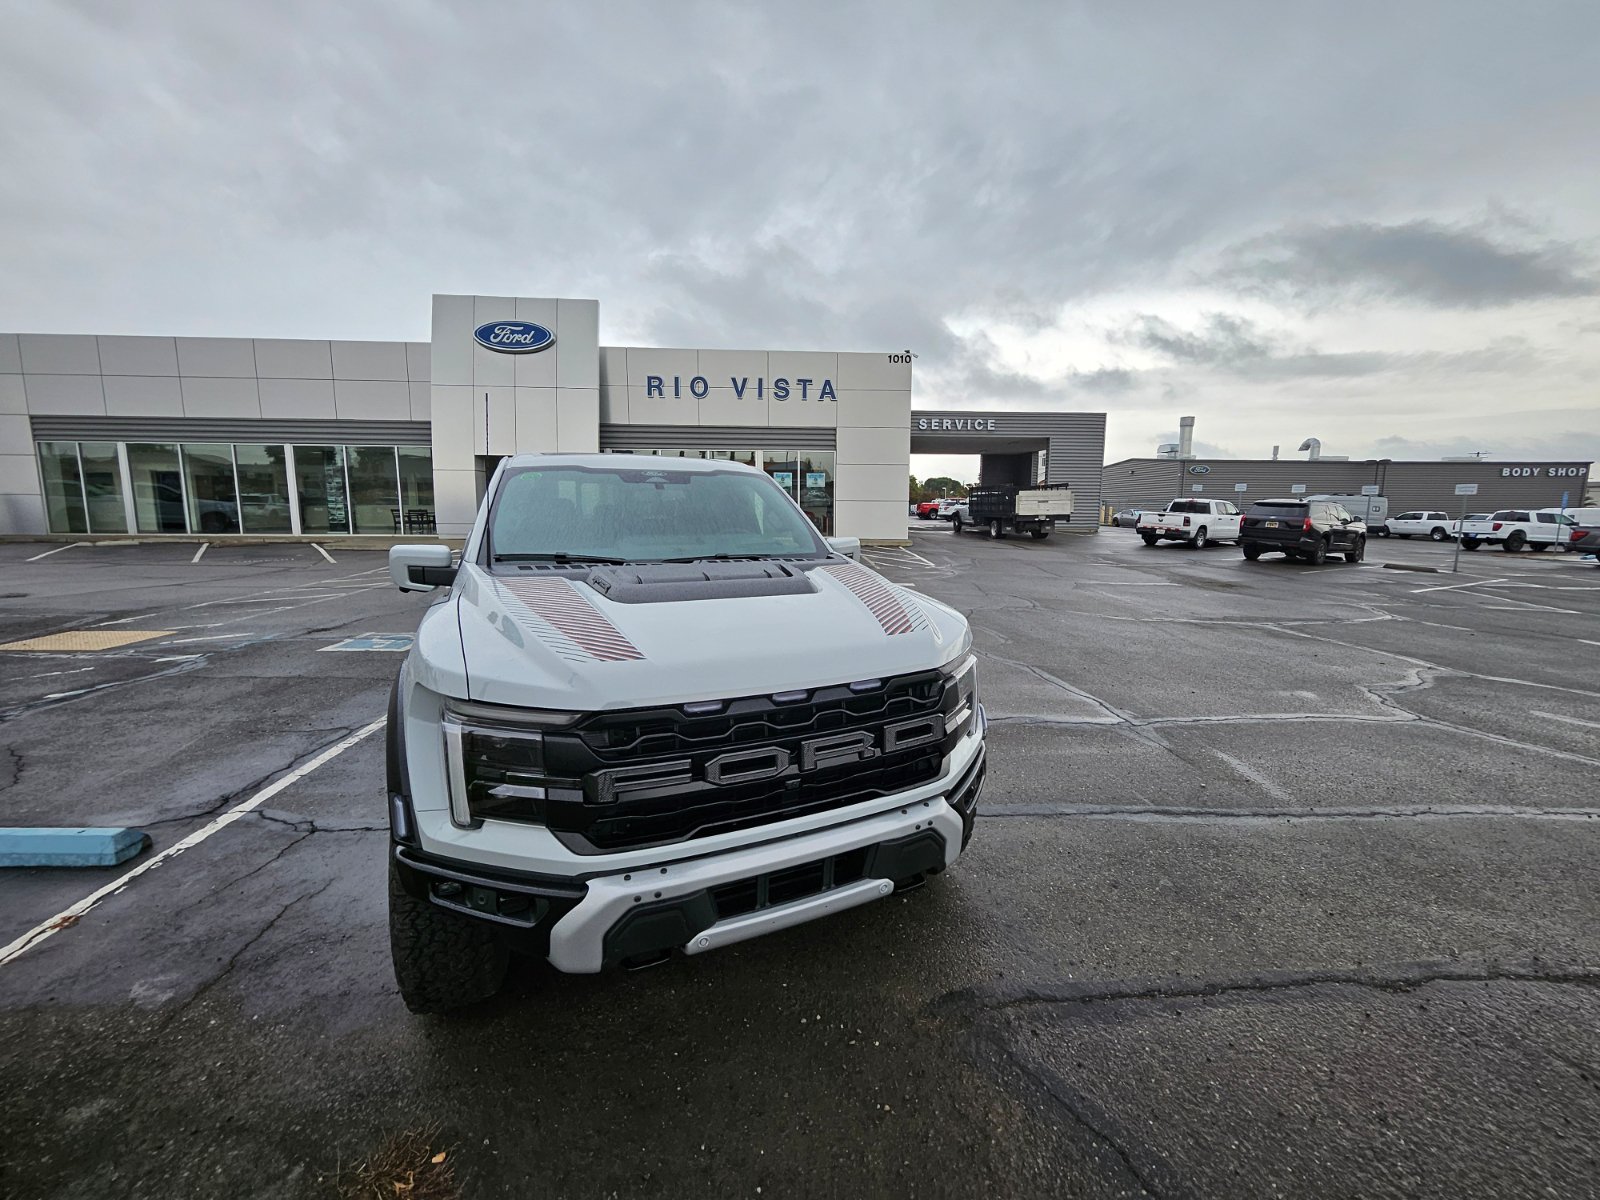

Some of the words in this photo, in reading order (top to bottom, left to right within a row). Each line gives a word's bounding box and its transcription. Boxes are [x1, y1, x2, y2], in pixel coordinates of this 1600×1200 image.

[490, 325, 535, 344] Ford
[887, 354, 912, 364] 1010
[647, 375, 709, 399] RIO
[731, 377, 838, 402] VISTA
[918, 418, 996, 431] SERVICE
[1502, 467, 1540, 477] BODY
[1548, 467, 1587, 477] SHOP
[583, 714, 944, 806] FORD
